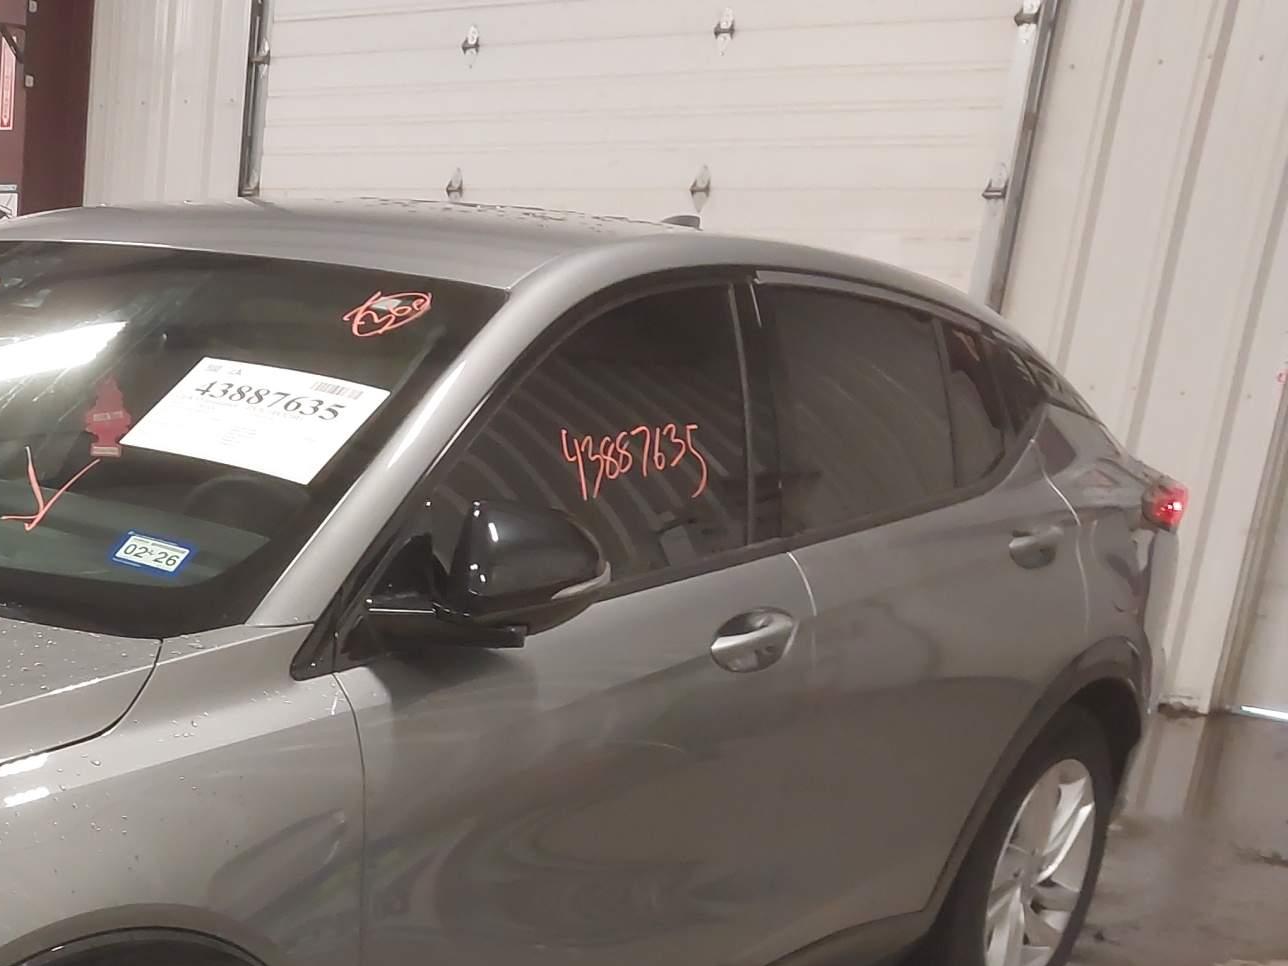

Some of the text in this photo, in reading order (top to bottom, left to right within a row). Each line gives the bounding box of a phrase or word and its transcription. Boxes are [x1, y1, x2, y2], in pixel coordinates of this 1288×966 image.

[194, 380, 346, 421] 43887635
[561, 423, 708, 501] 43887635
[123, 543, 149, 559] 02
[152, 551, 180, 567] 26
